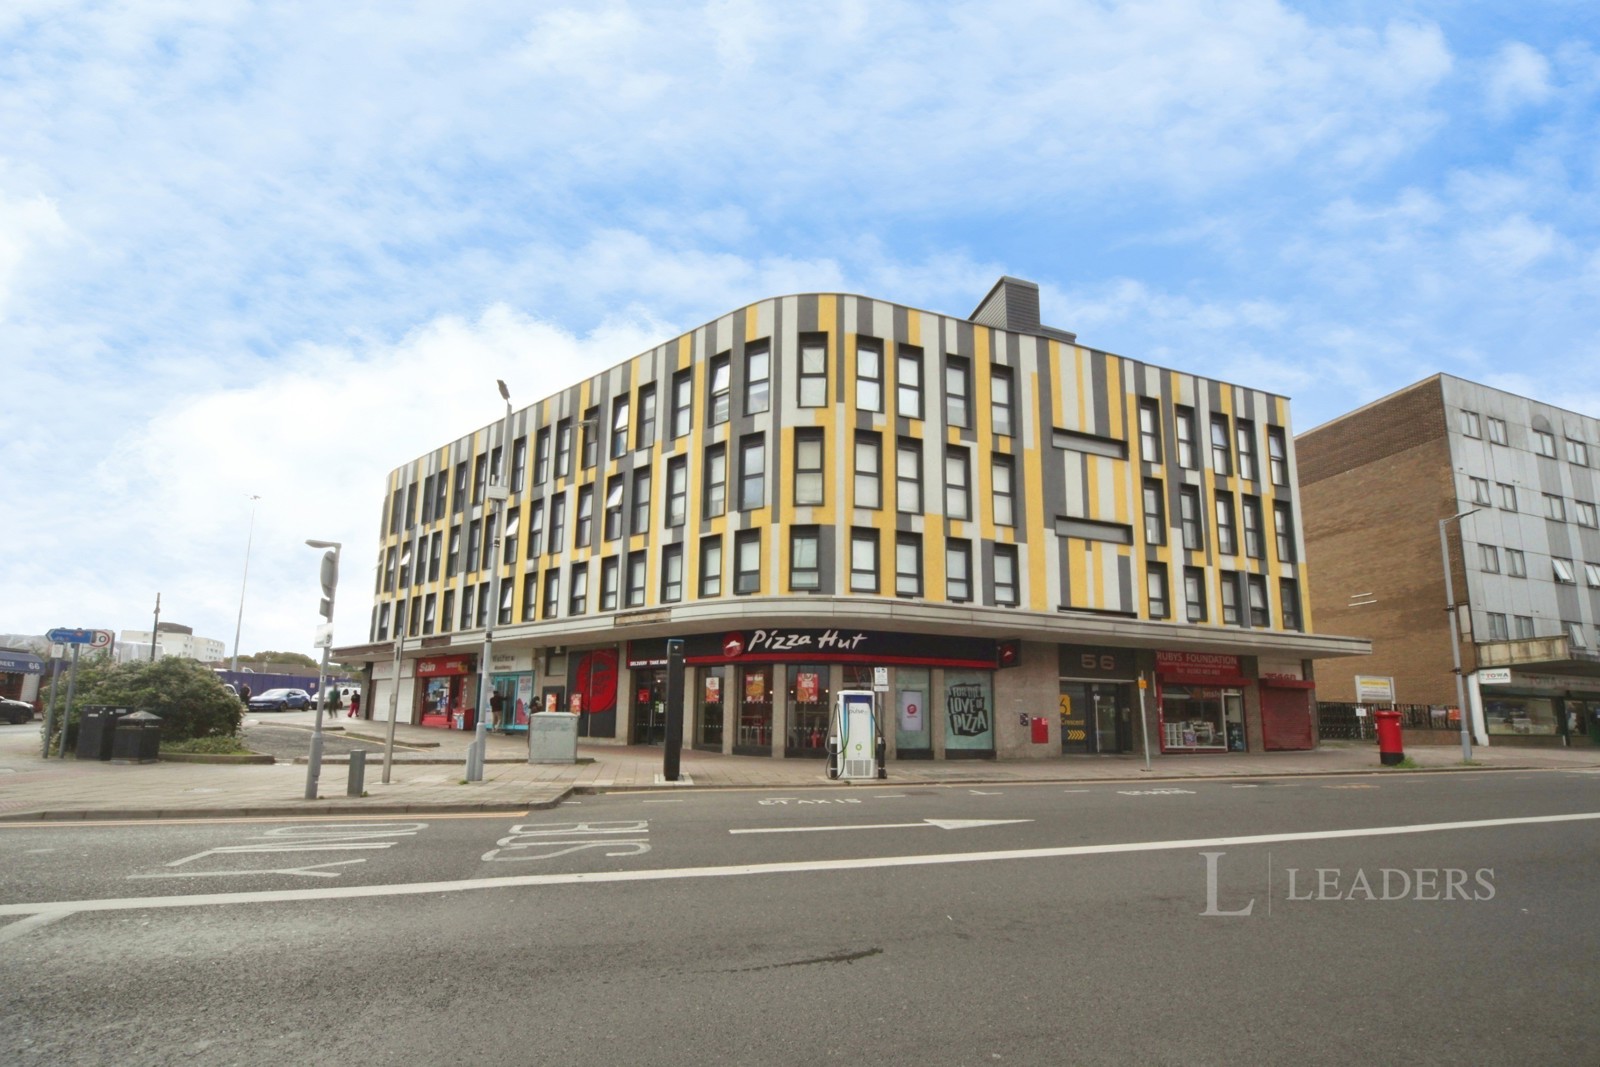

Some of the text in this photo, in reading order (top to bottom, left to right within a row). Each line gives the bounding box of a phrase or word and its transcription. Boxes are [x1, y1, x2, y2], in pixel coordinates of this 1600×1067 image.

[748, 629, 868, 652] Pizza Hut
[1081, 654, 1114, 670] 56
[1156, 651, 1237, 664] RUBYS FOUNDATION
[28, 662, 41, 670] 66
[949, 697, 976, 714] LOVE
[952, 710, 987, 735] PIZZA
